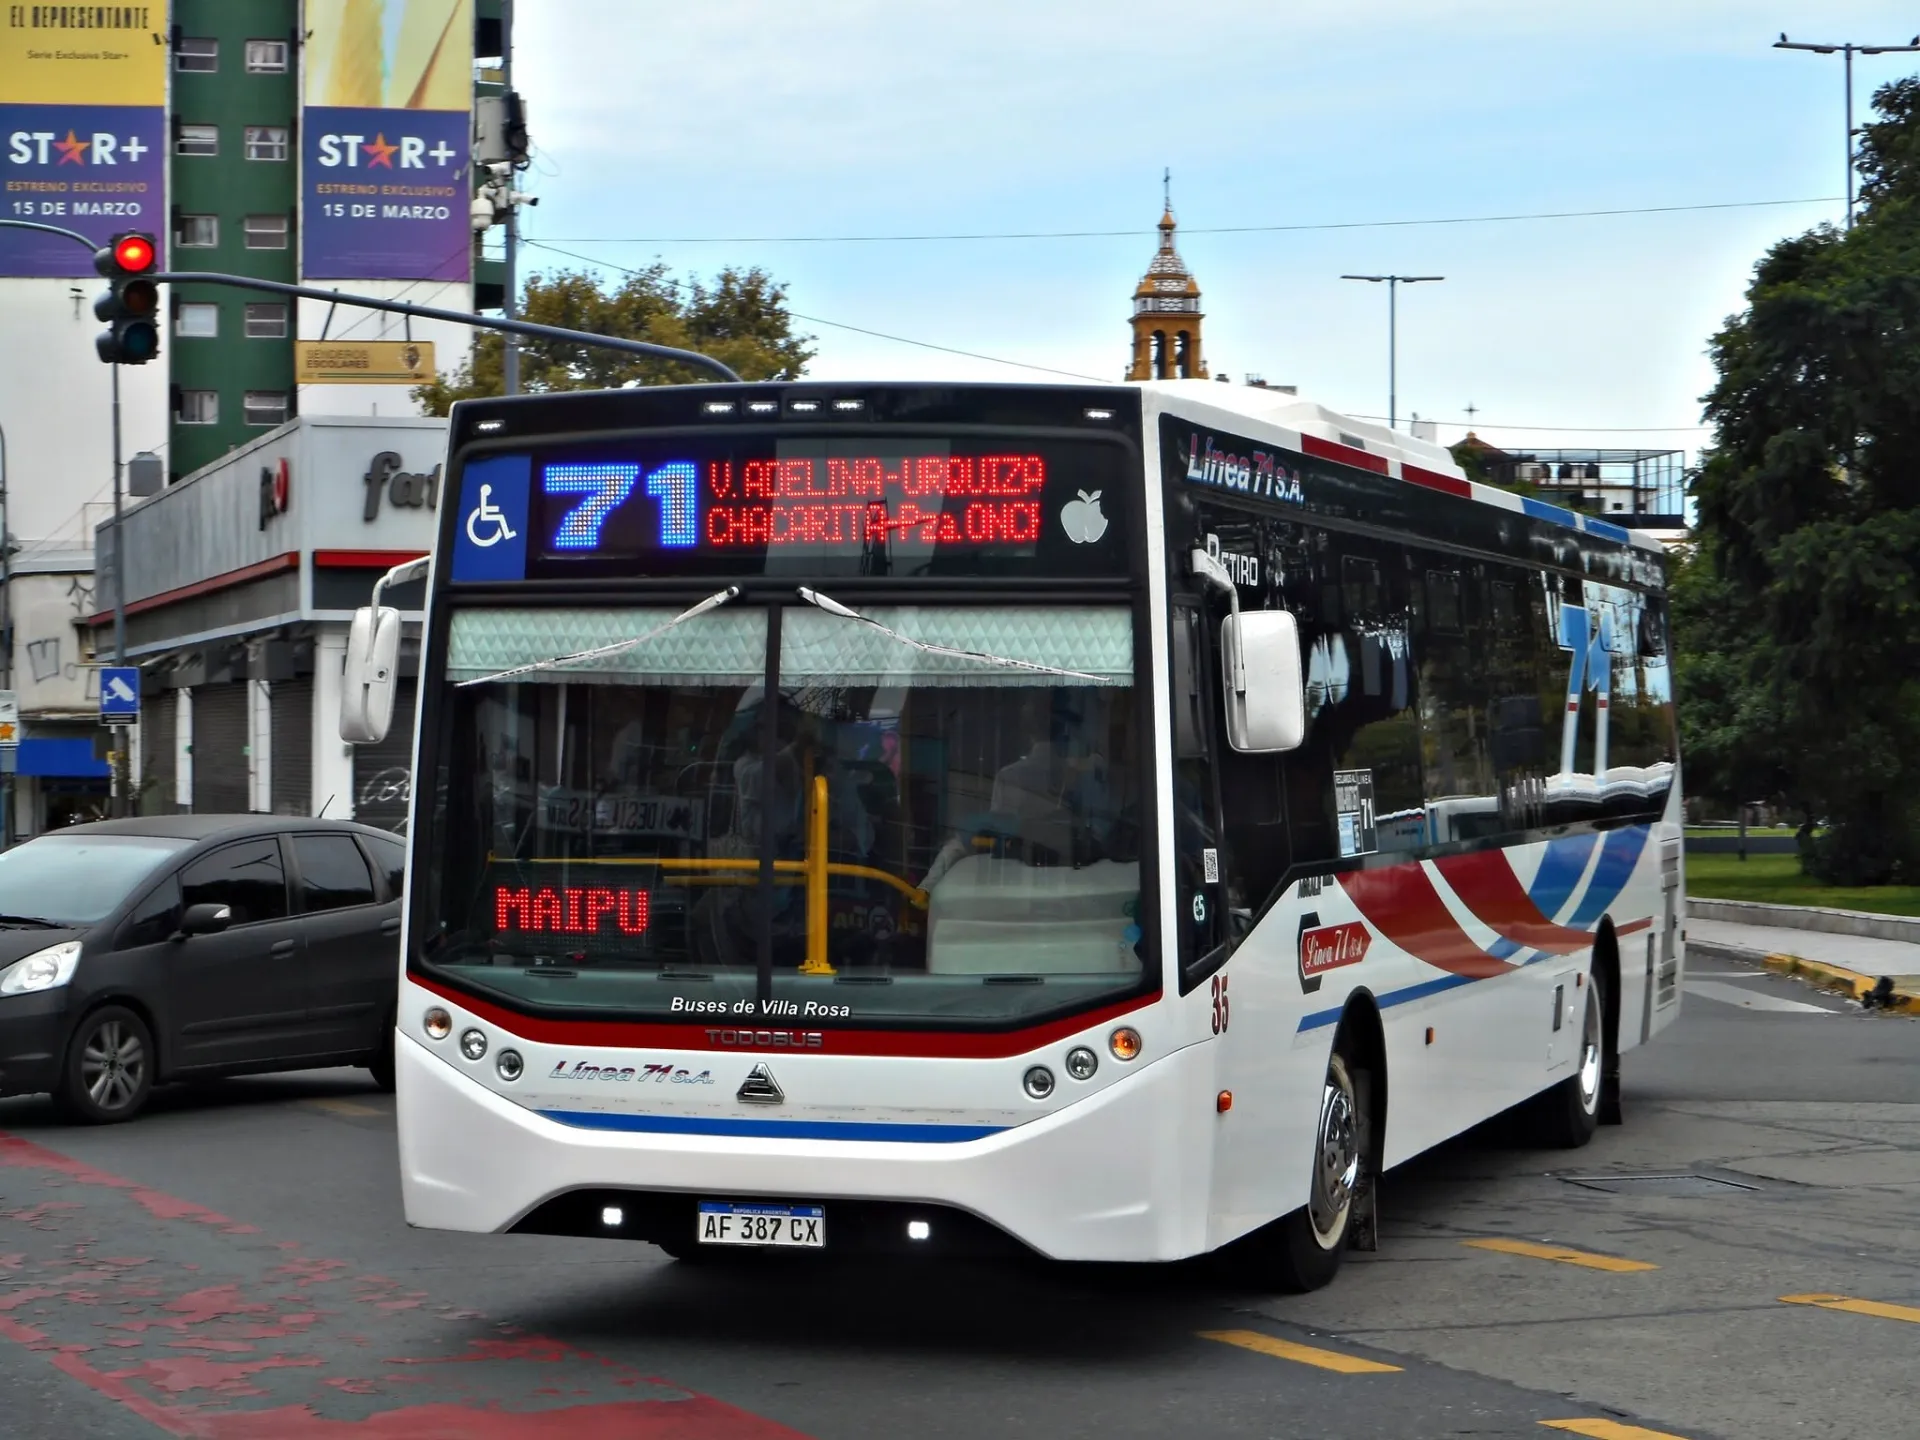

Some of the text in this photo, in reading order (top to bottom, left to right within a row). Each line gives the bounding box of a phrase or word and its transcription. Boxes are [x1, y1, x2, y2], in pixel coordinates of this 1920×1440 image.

[10, 5, 149, 29] EL REPRESENTANTE
[27, 50, 52, 59] Serie
[103, 51, 129, 60] Star+
[7, 181, 148, 193] ESTRENO EXCLUSIVO
[317, 184, 456, 197] ESTRENO EXCLUSIVO
[13, 202, 142, 216] 15 DE MARZO
[323, 204, 450, 220] 15 DE MARZO
[306, 350, 368, 359] SENDEROS
[307, 360, 369, 369] ESCOLARES
[544, 462, 697, 547] 71
[496, 886, 649, 933] MAIPU
[671, 996, 851, 1017] Buses de Villa Rosa
[1211, 973, 1229, 1035] 35
[705, 1029, 823, 1048] TODOBUS
[549, 1060, 636, 1082] Línea
[637, 1064, 675, 1083] 71
[704, 1215, 818, 1242] AF 387 CX
